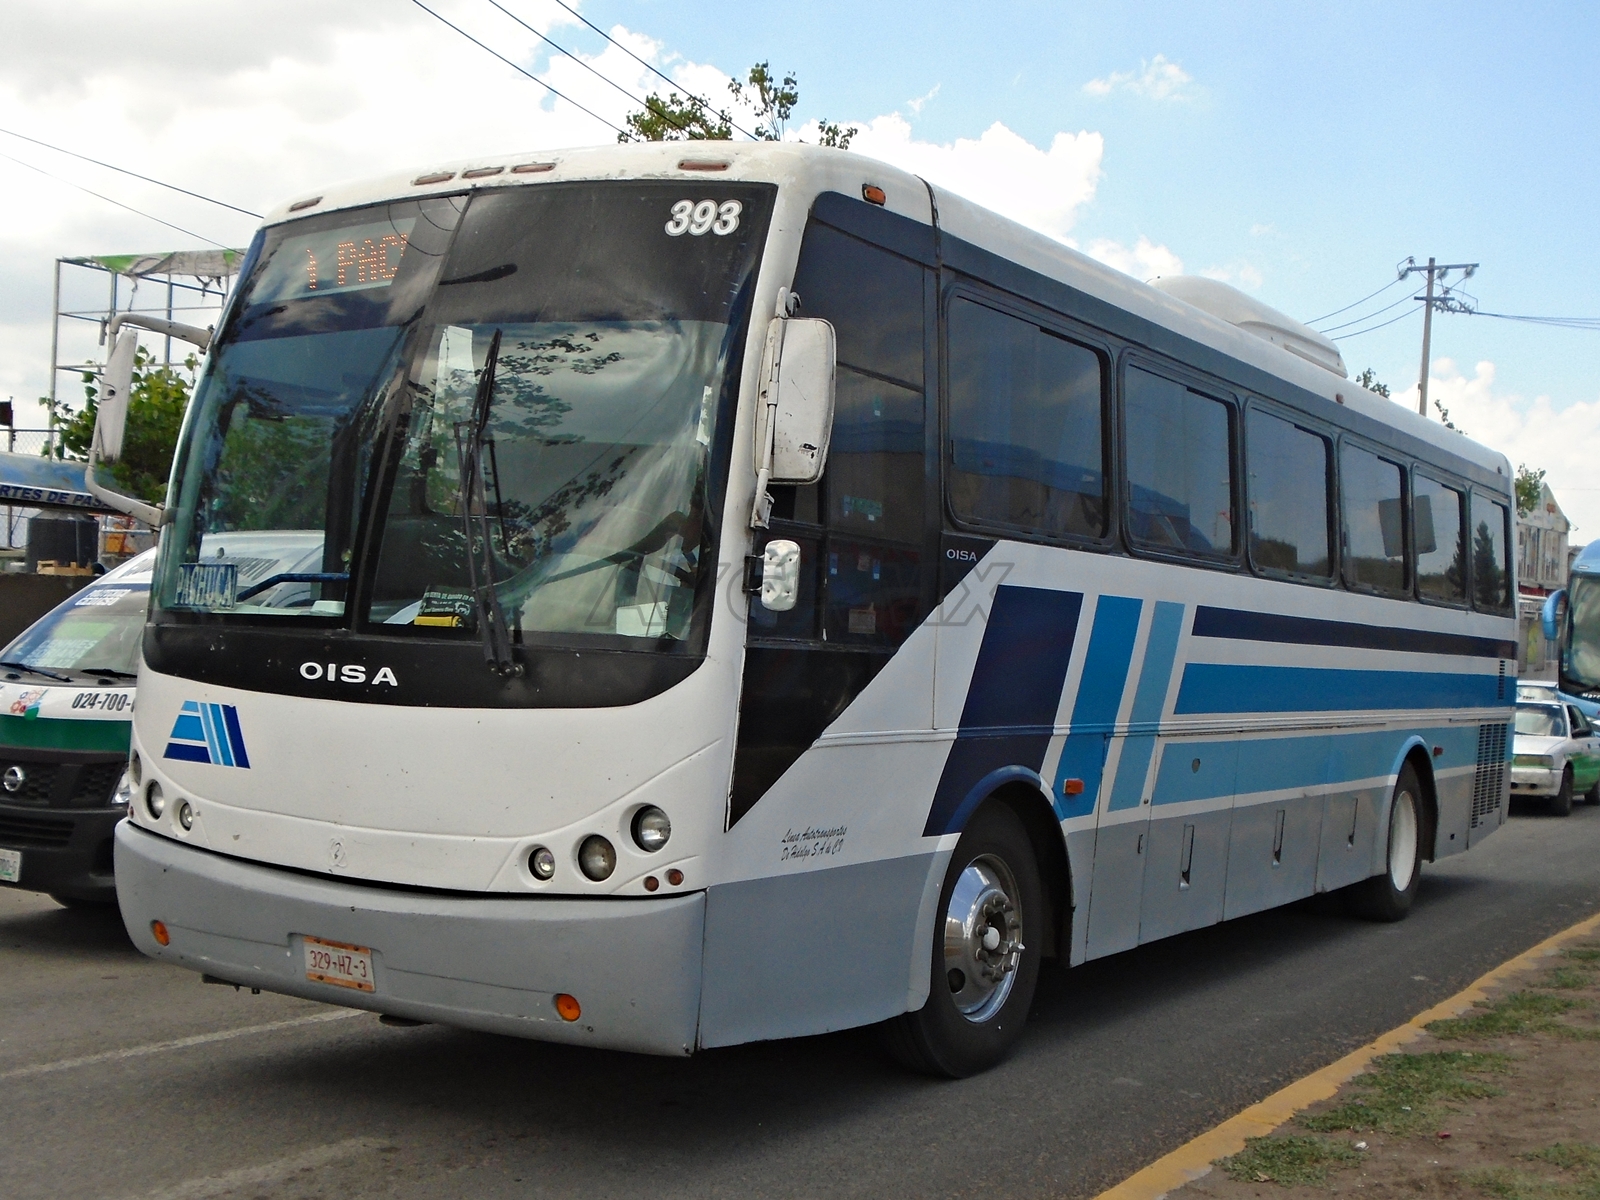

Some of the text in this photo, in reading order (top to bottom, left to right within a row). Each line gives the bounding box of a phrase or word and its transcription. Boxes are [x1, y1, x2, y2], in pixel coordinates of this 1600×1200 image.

[665, 199, 742, 236] 393
[46, 490, 68, 504] DE
[946, 549, 977, 562] OISA
[173, 564, 236, 608] PACHUCA
[299, 661, 398, 687] OISA
[309, 949, 367, 978] 329-HZ-3
